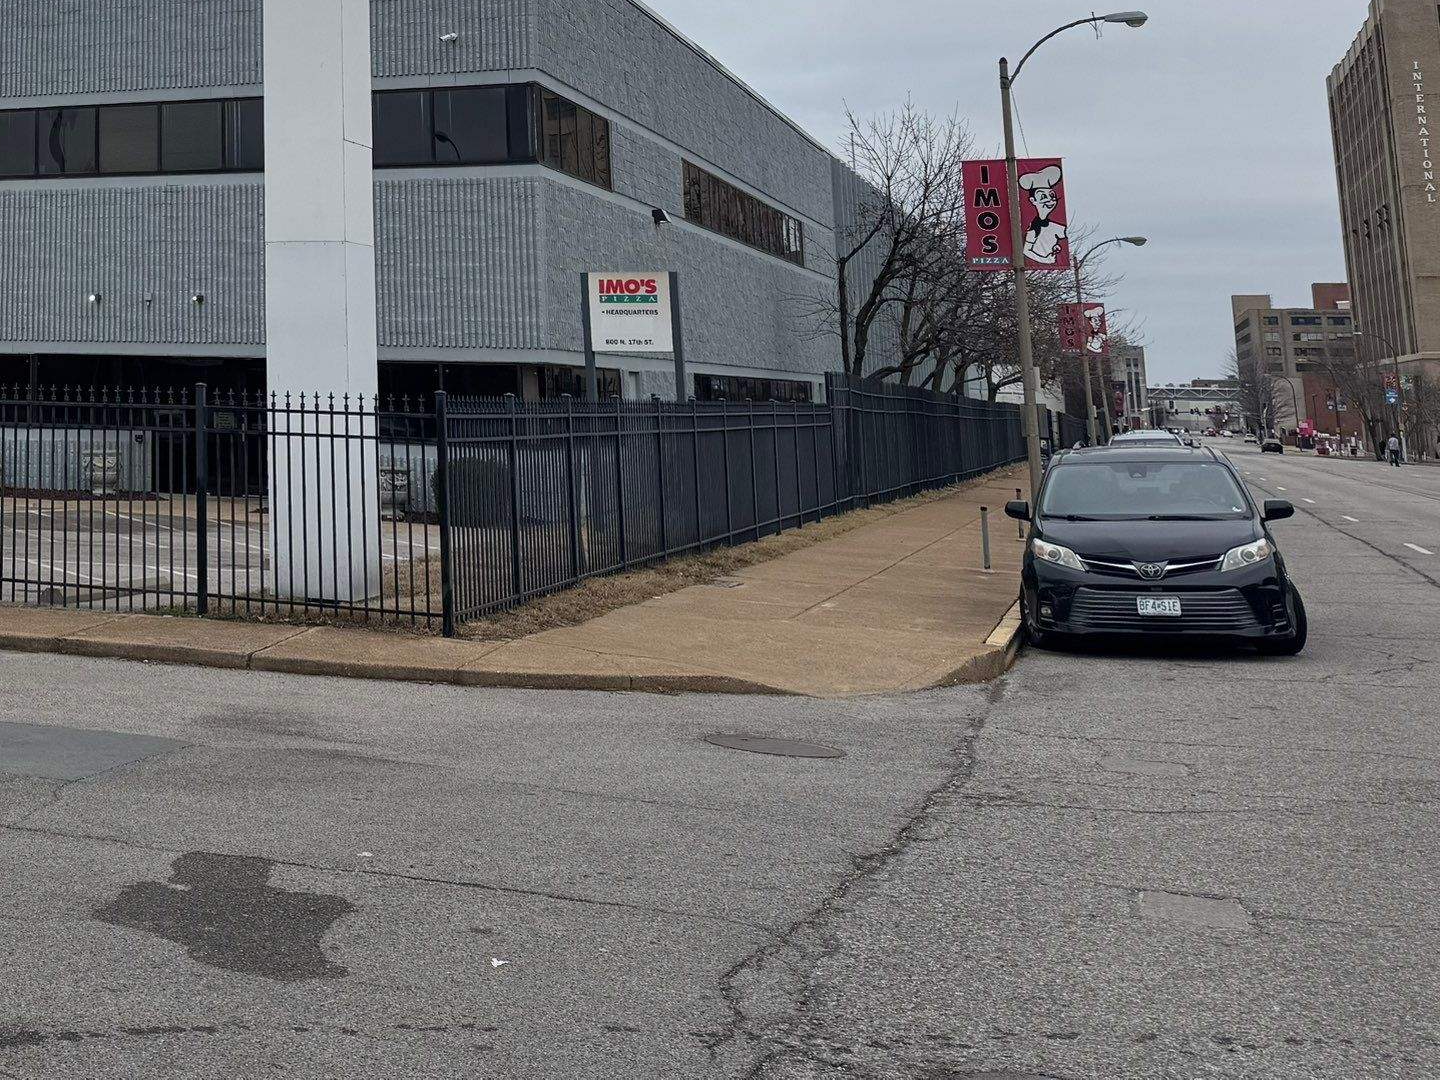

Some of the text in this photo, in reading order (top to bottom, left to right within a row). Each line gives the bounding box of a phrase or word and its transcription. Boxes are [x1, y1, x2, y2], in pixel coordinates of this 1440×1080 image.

[1412, 61, 1436, 203] INTERNATIONAL
[971, 256, 1009, 264] PIZZA
[598, 278, 657, 295] IMO'S
